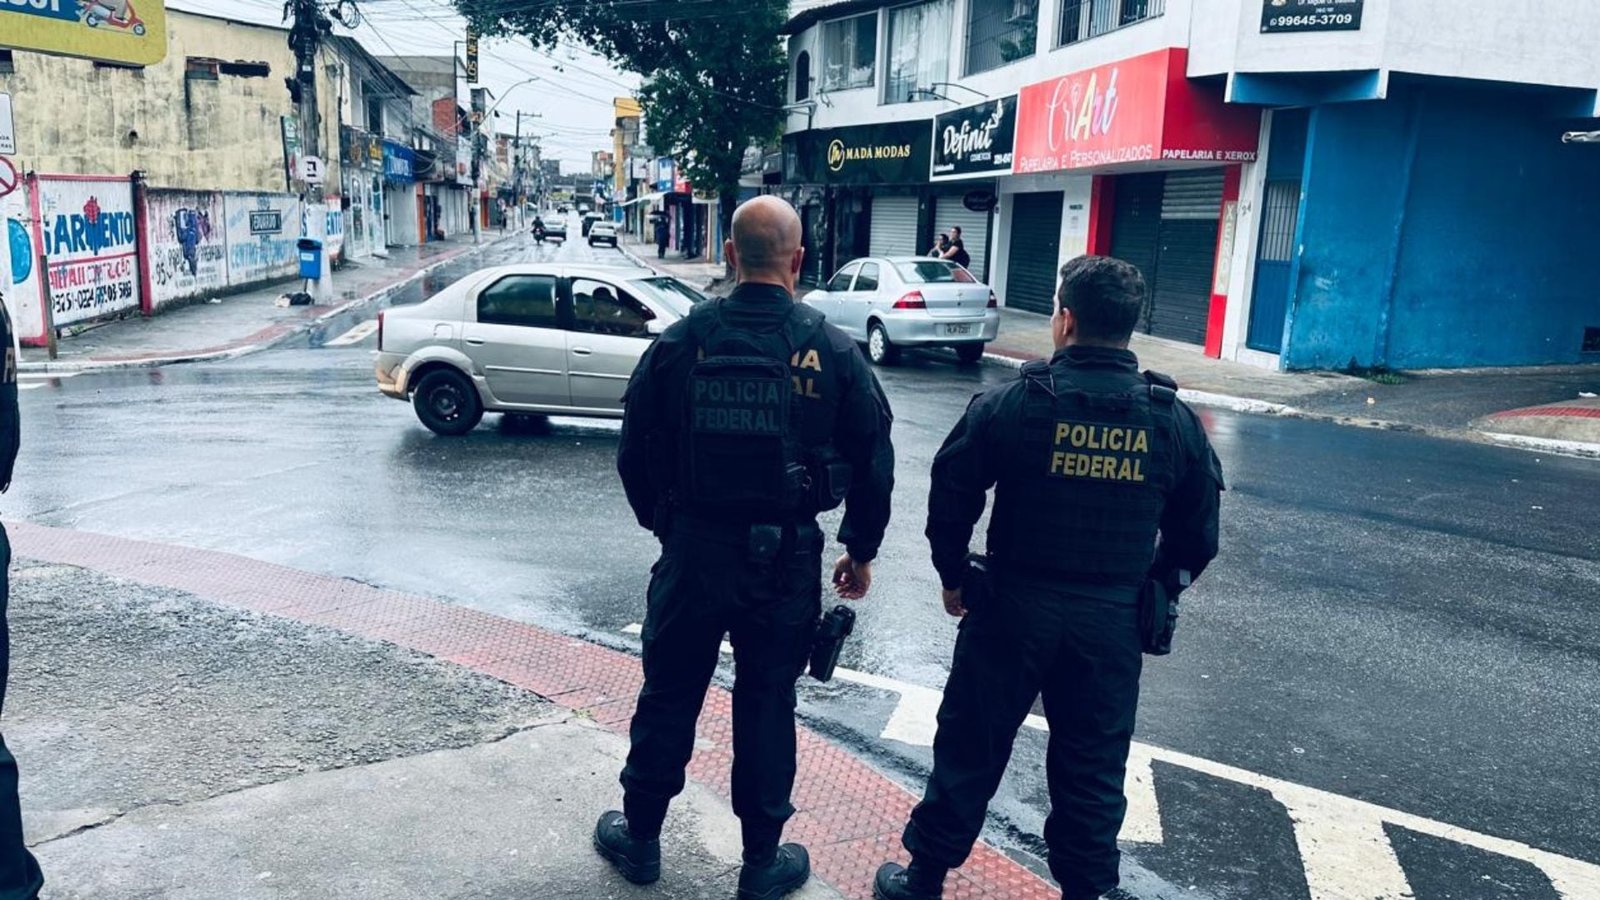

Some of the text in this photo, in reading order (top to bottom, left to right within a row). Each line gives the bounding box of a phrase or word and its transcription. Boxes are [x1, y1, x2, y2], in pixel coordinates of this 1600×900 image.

[1278, 14, 1352, 26] 99645-3709
[874, 144, 911, 159] MODAS
[1162, 149, 1256, 161] PAPELARIA E XEROX
[1061, 154, 1068, 169] E
[694, 407, 780, 432] FEDERAL
[1050, 451, 1146, 482] FEDERAL
